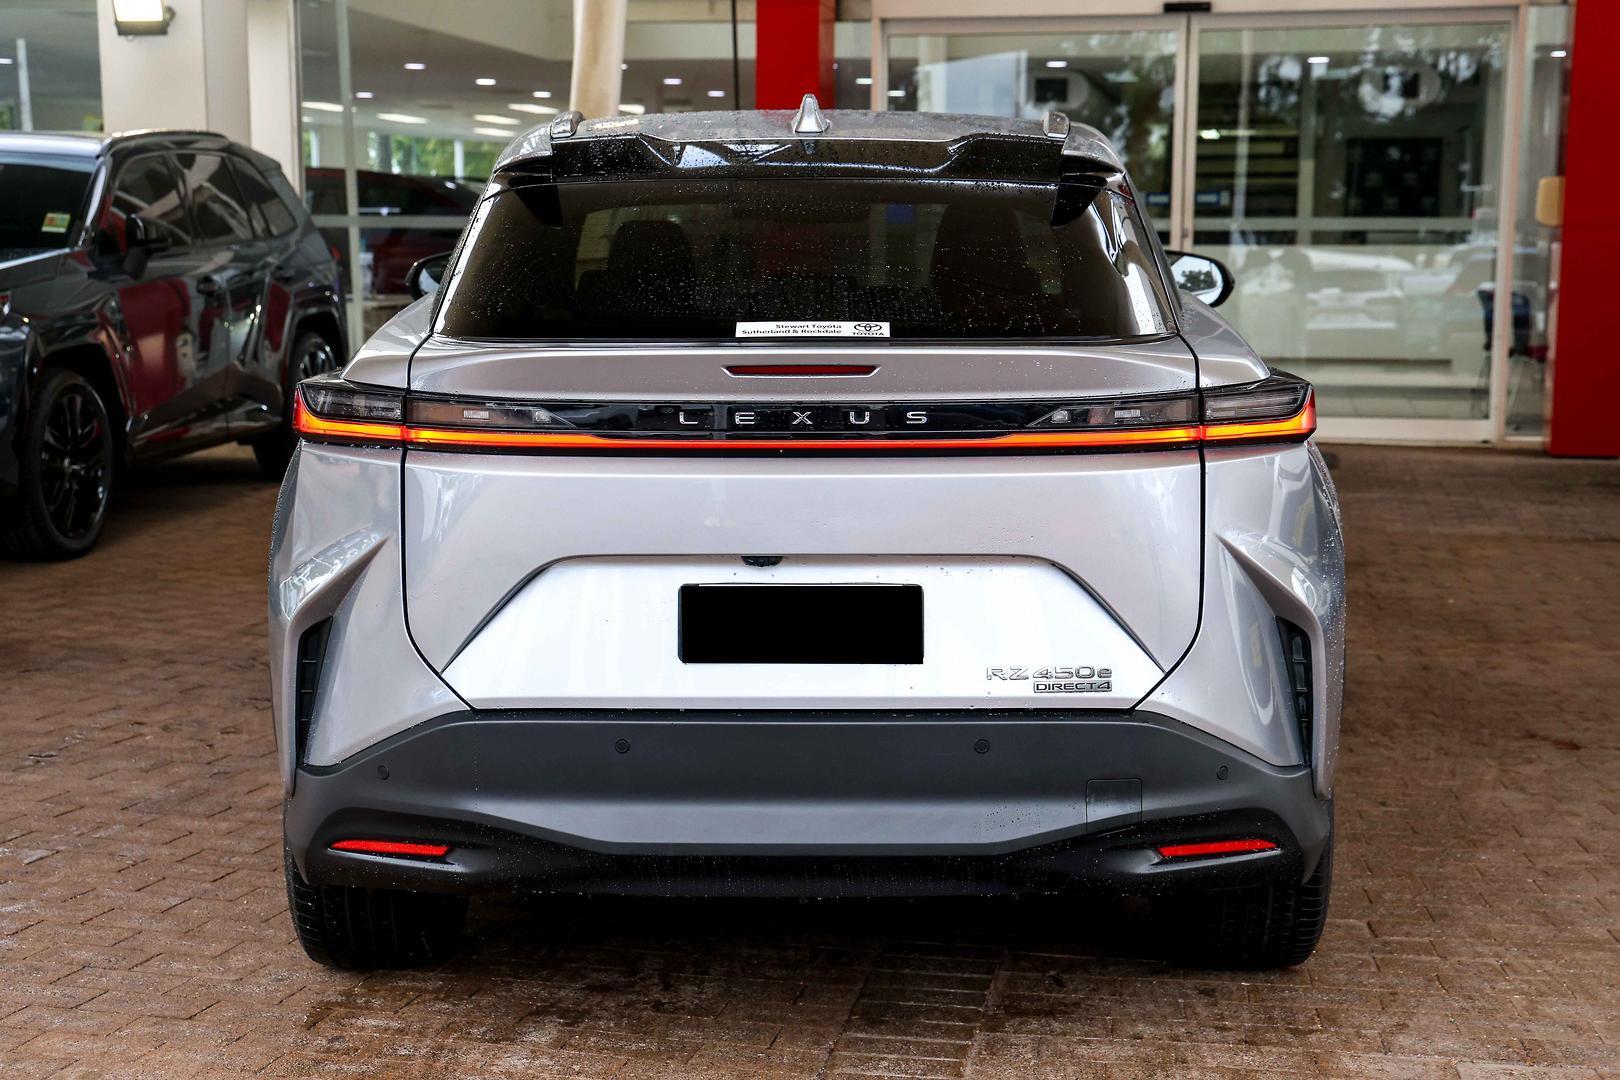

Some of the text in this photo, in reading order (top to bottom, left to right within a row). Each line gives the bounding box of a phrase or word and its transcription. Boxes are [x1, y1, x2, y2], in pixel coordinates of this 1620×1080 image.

[812, 323, 843, 331] Toyota
[679, 411, 928, 425] LEXUS
[986, 666, 1112, 680] RZ 450e
[1036, 681, 1111, 691] DIRECT4
